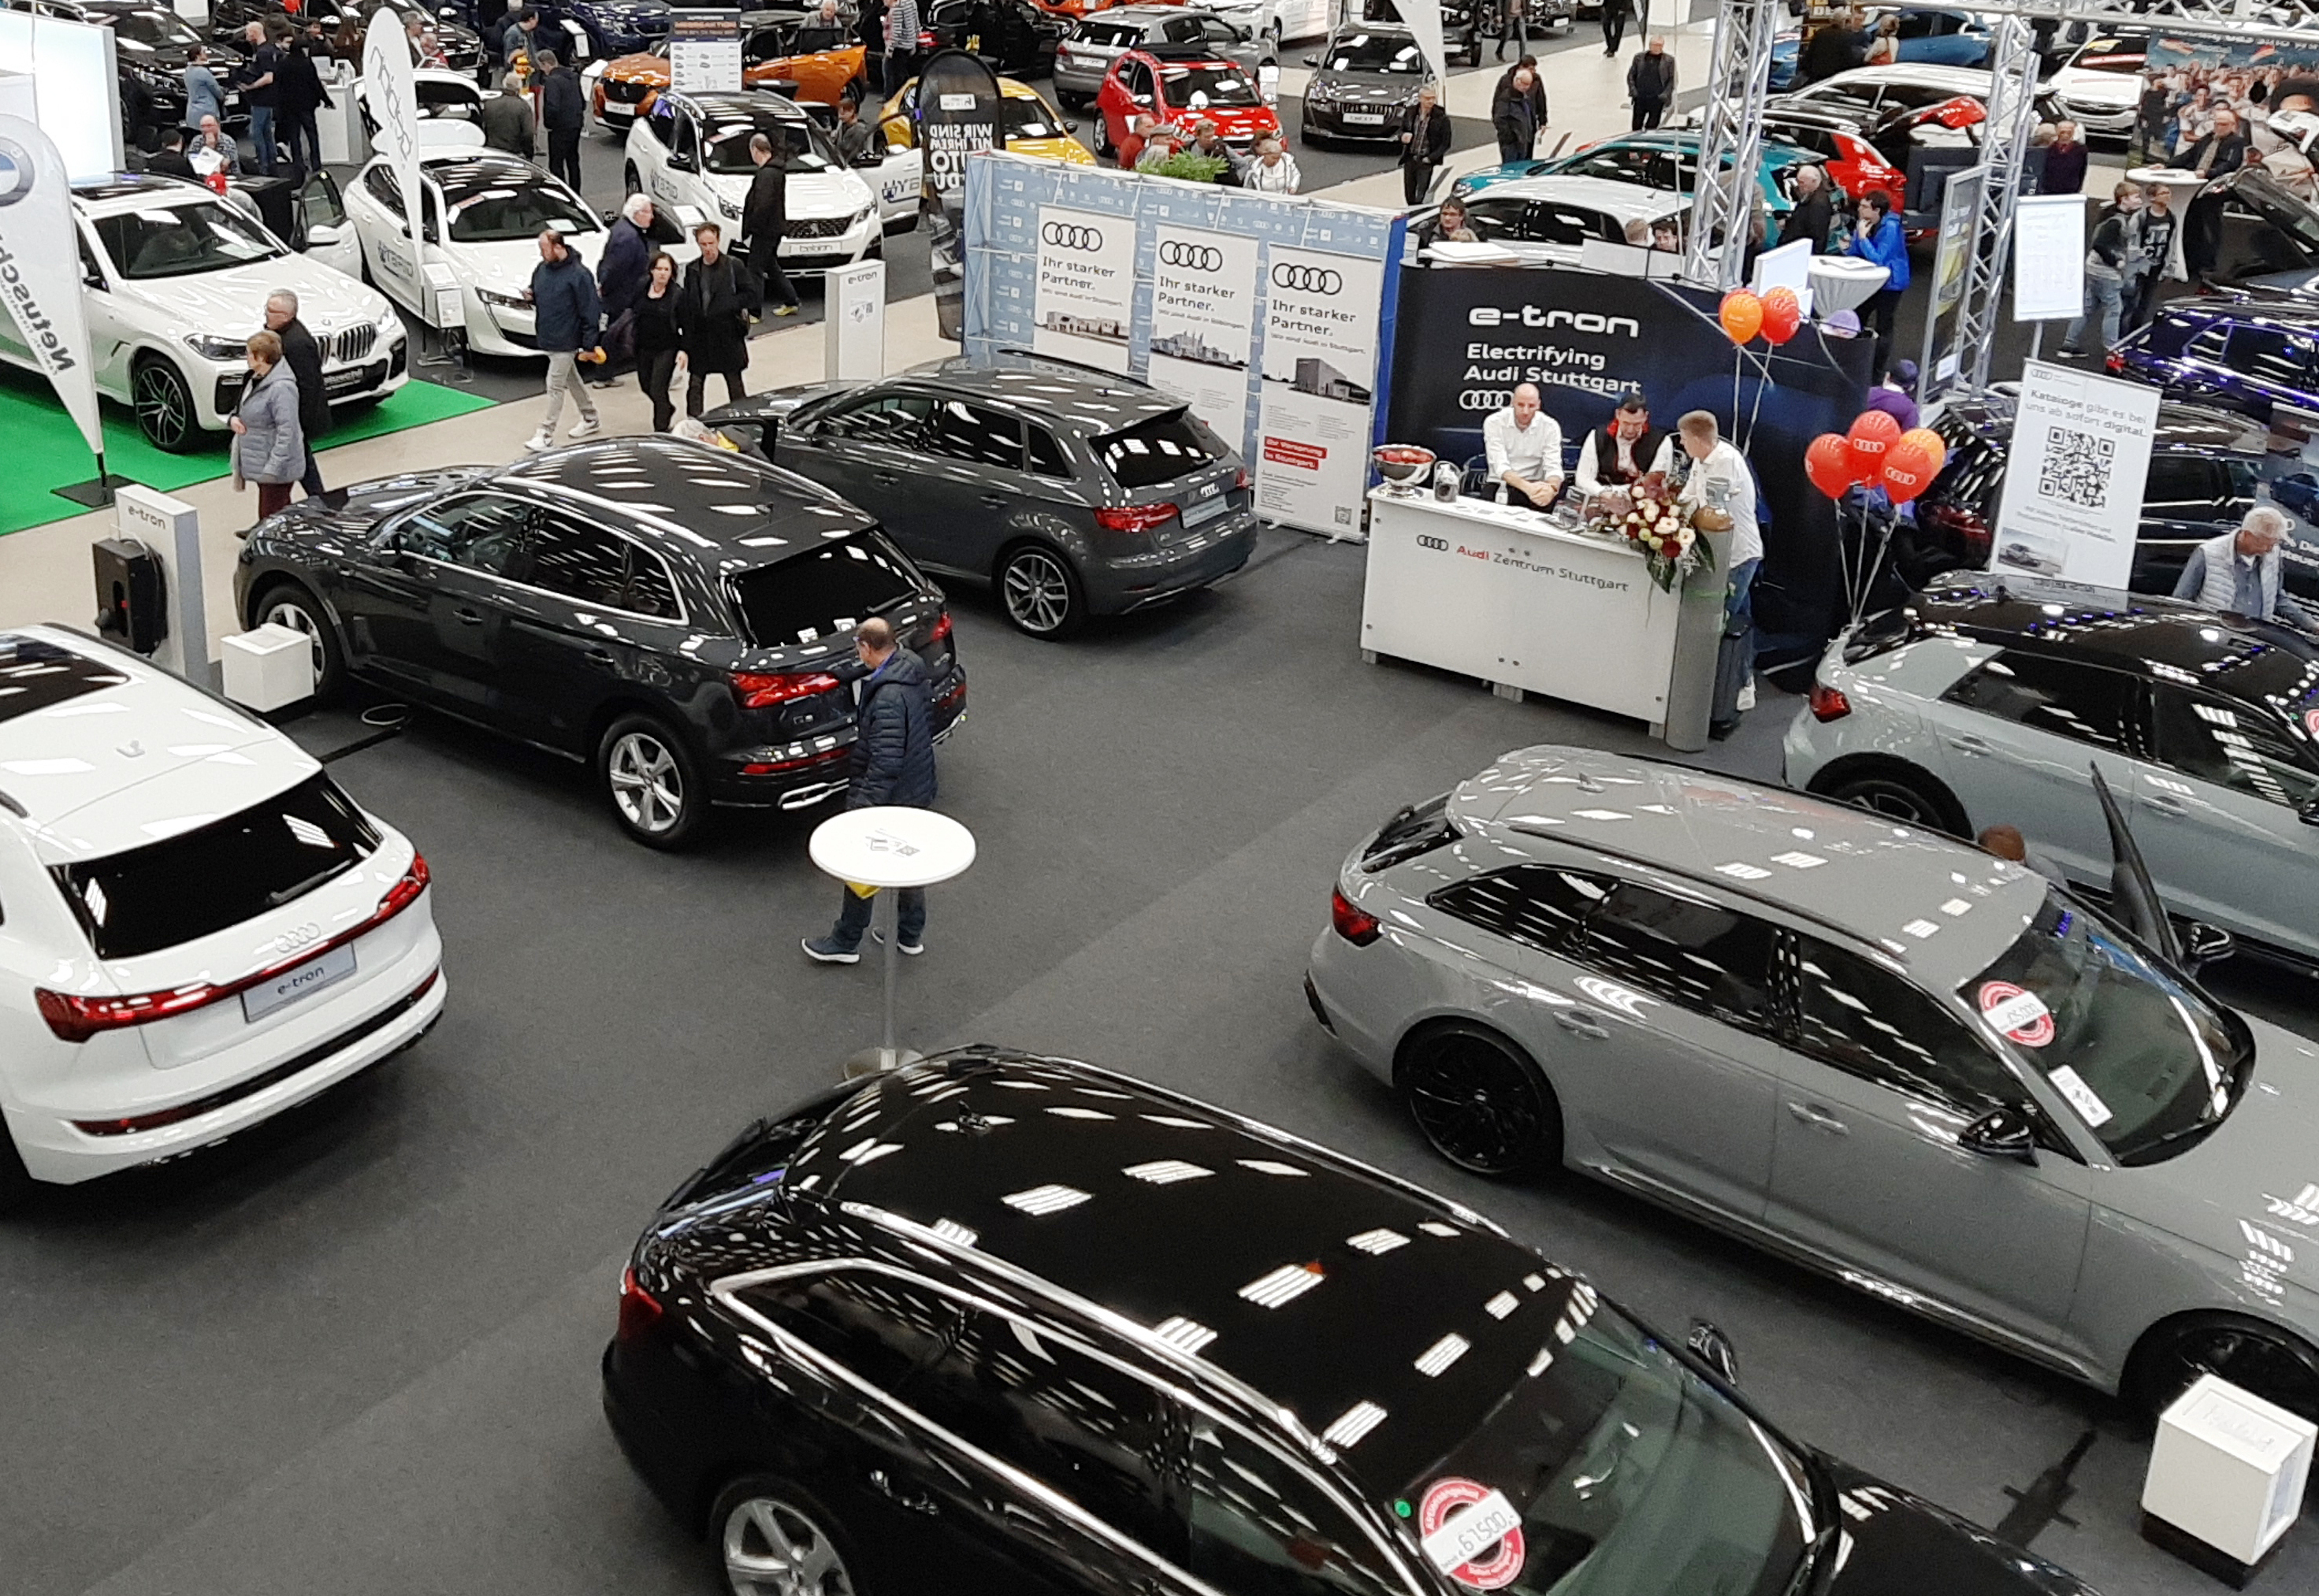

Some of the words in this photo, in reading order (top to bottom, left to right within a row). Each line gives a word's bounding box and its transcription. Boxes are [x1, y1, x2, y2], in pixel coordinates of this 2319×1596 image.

[1042, 256, 1063, 269] Ihr
[1066, 262, 1116, 277] starker
[1042, 272, 1096, 291] Partner.
[1160, 276, 1180, 289] Ihr
[1184, 282, 1235, 299] starker
[1158, 291, 1215, 312] Partner.
[1273, 299, 1295, 313] Ihr
[1300, 306, 1356, 322] starker
[1271, 315, 1333, 336] Partner.
[1469, 305, 1639, 337] e-tron
[1466, 343, 1606, 371] Electrifying
[1463, 365, 1519, 381] Audi
[1525, 366, 1642, 395] Stuttgart
[128, 503, 166, 529] e-tron
[1456, 545, 1489, 561] Audi
[1493, 553, 1555, 576] Zentrum
[1559, 567, 1630, 592] Stuttgart
[277, 967, 325, 995] e-tron
